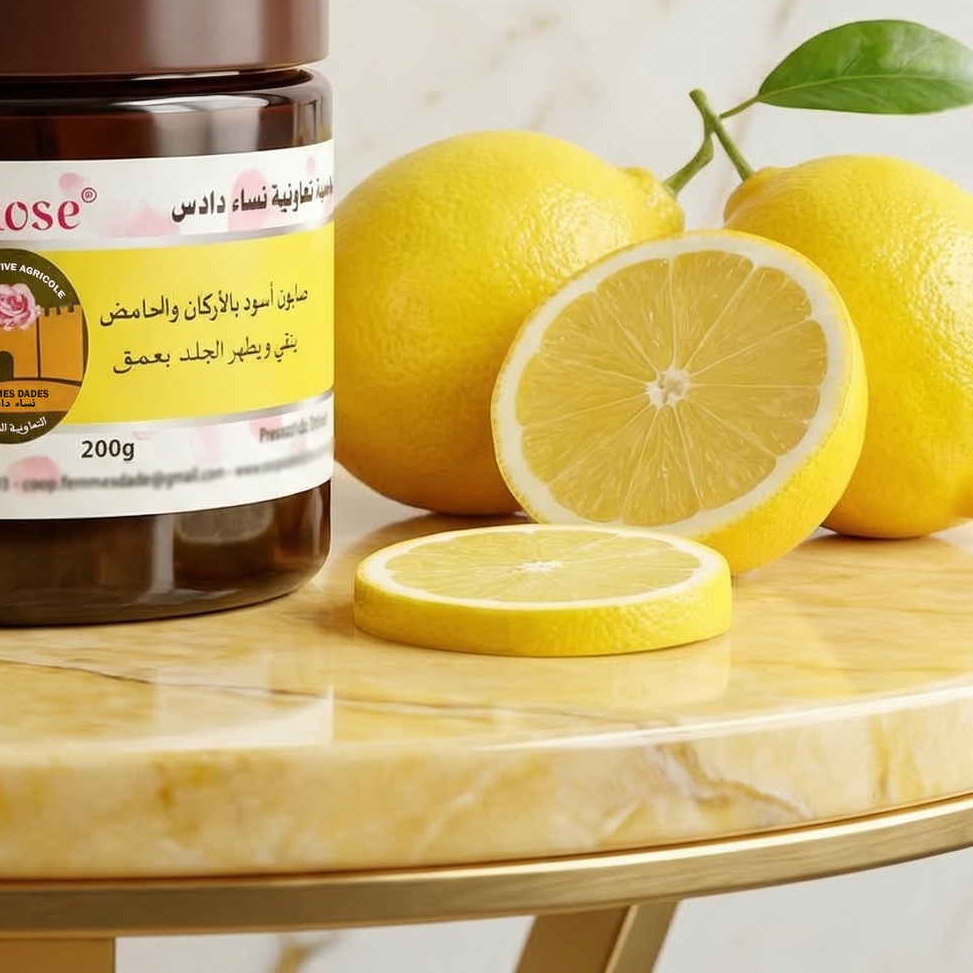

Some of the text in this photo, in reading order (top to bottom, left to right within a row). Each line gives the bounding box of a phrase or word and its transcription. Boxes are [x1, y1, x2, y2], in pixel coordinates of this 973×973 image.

[172, 189, 226, 223] دادس
[232, 185, 268, 212] نساء
[18, 264, 66, 300] AGRICOLE
[99, 281, 308, 327] صابون أسود بالأركان والحامض
[113, 350, 170, 374] بعمق
[179, 339, 224, 365] الجلد
[15, 398, 36, 408] نساء
[17, 389, 49, 398] DADES
[80, 439, 135, 462] 200g
